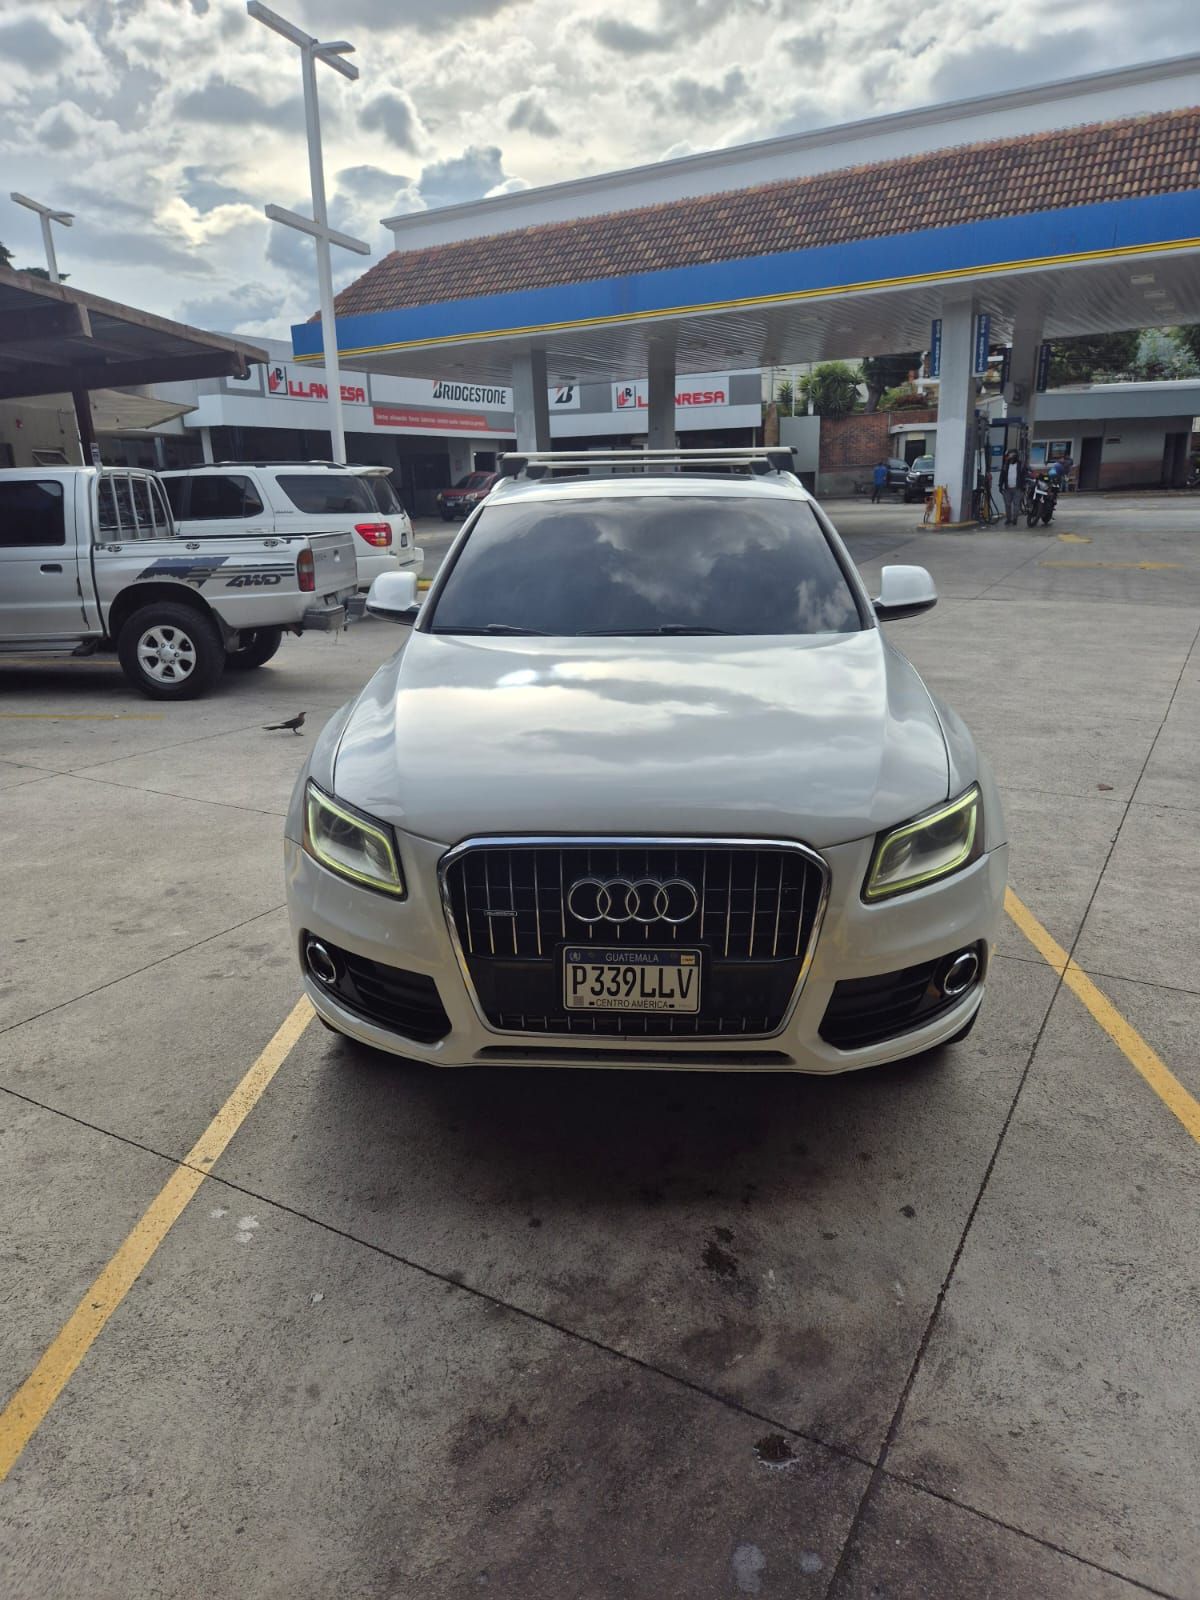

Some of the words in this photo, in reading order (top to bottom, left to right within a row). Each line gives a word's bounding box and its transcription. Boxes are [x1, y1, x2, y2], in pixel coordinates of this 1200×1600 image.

[288, 380, 366, 403] LLANESA
[433, 379, 507, 405] BRIDGESTONE
[637, 390, 725, 408] LNRESA
[226, 573, 282, 588] 4WD
[606, 952, 659, 962] GUATEMALA
[572, 965, 693, 999] P339LLV
[596, 998, 630, 1008] CENTRO
